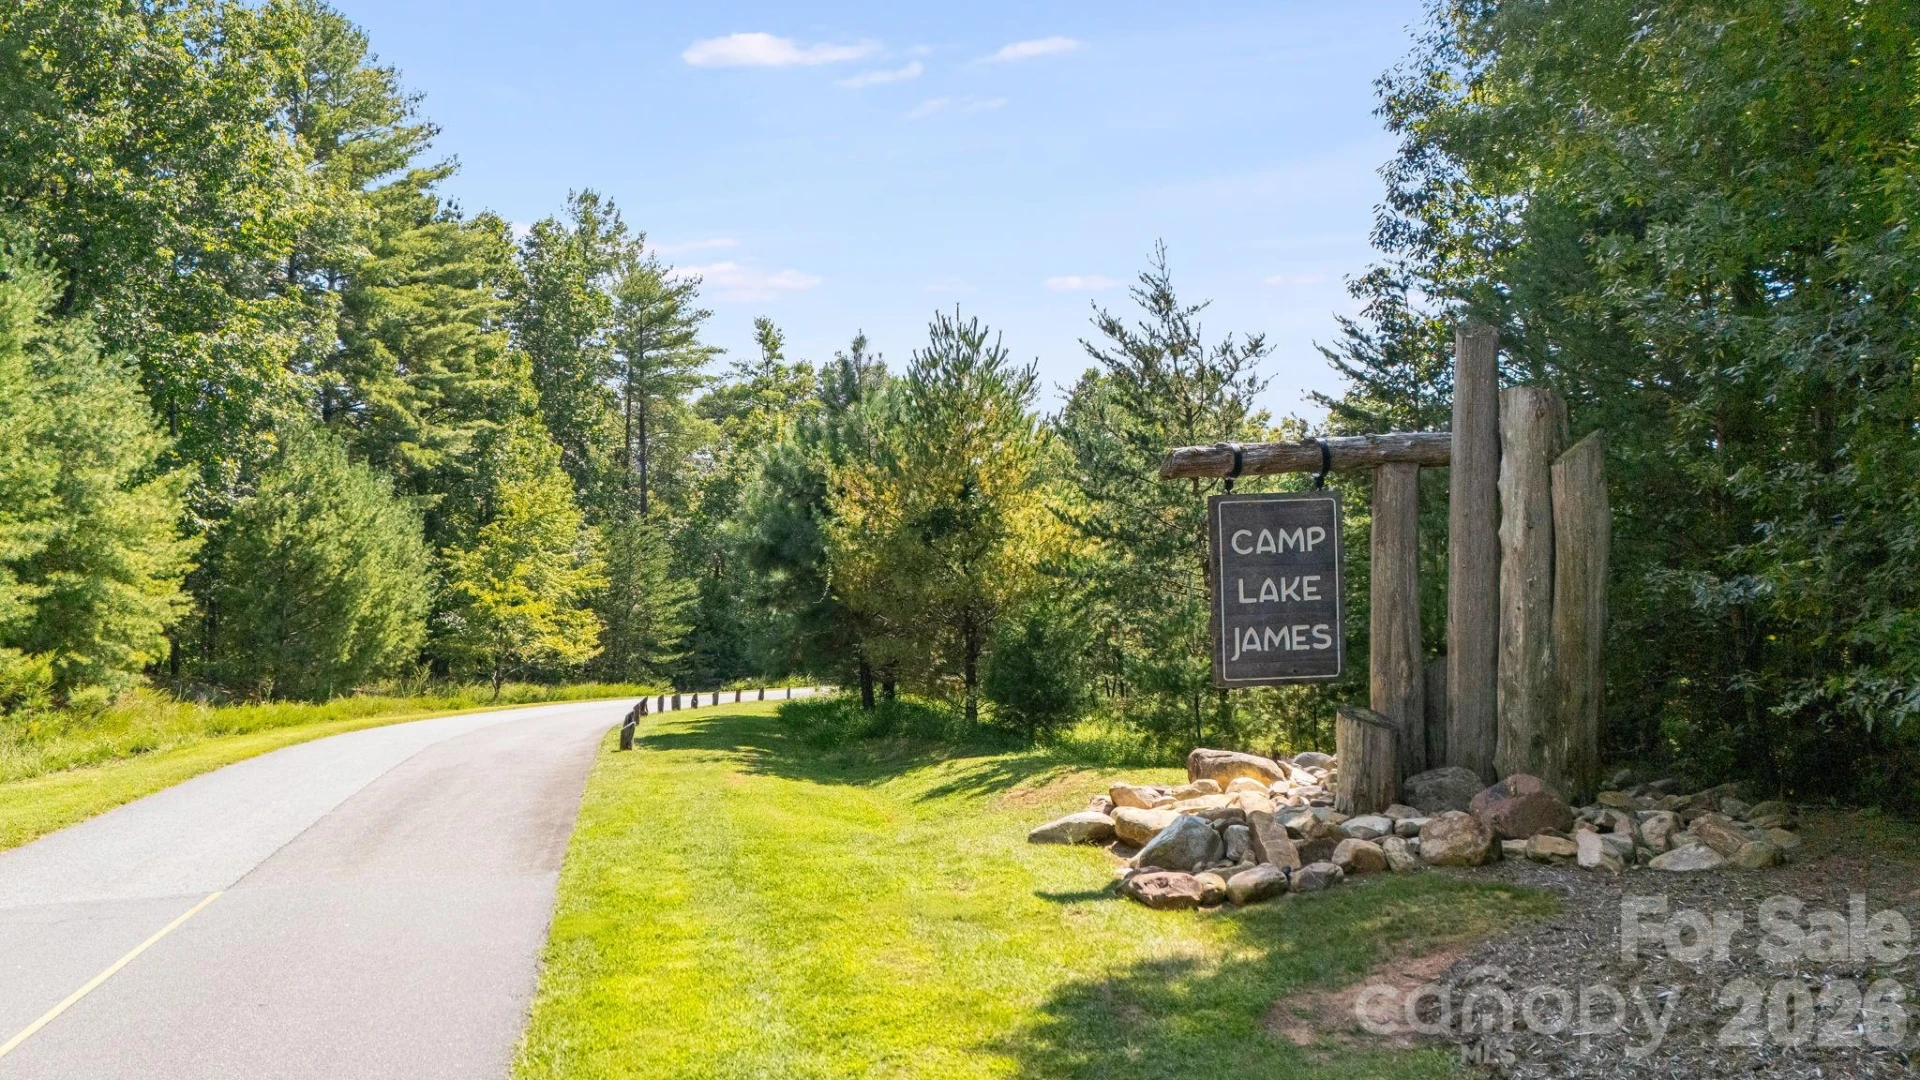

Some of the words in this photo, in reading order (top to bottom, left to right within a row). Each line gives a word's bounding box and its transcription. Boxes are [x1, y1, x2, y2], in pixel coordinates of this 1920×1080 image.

[1231, 526, 1325, 555] CAMP
[1238, 575, 1322, 604] LAKE
[1230, 623, 1332, 662] JAMES
